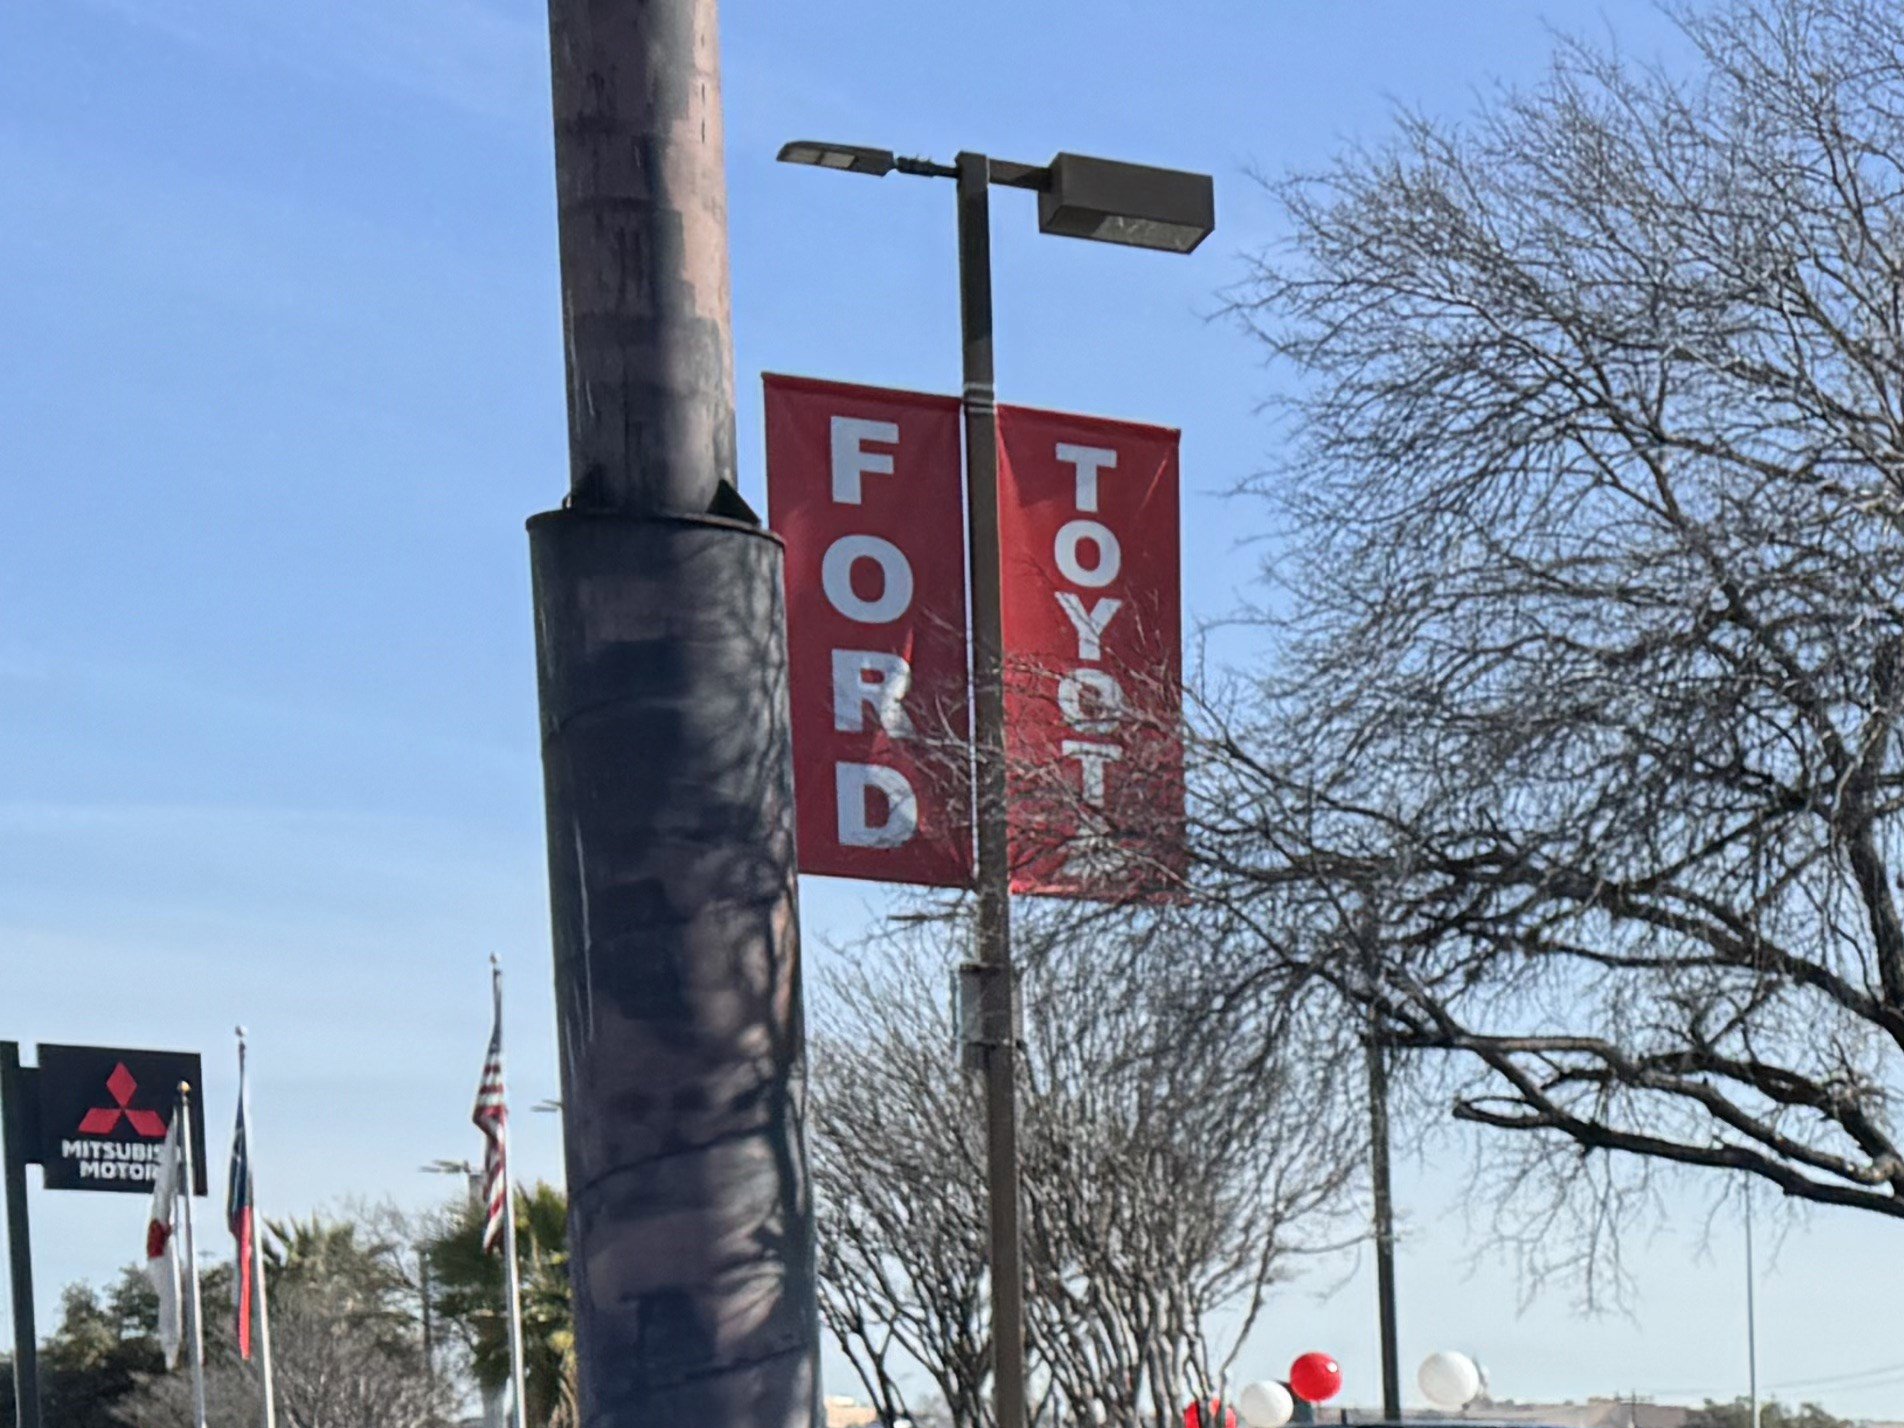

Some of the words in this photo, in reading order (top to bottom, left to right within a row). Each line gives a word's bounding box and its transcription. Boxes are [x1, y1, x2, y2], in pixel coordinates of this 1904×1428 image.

[821, 416, 919, 849] FORD
[62, 1139, 182, 1163] MITSUBI
[79, 1160, 160, 1181] MOTOR
